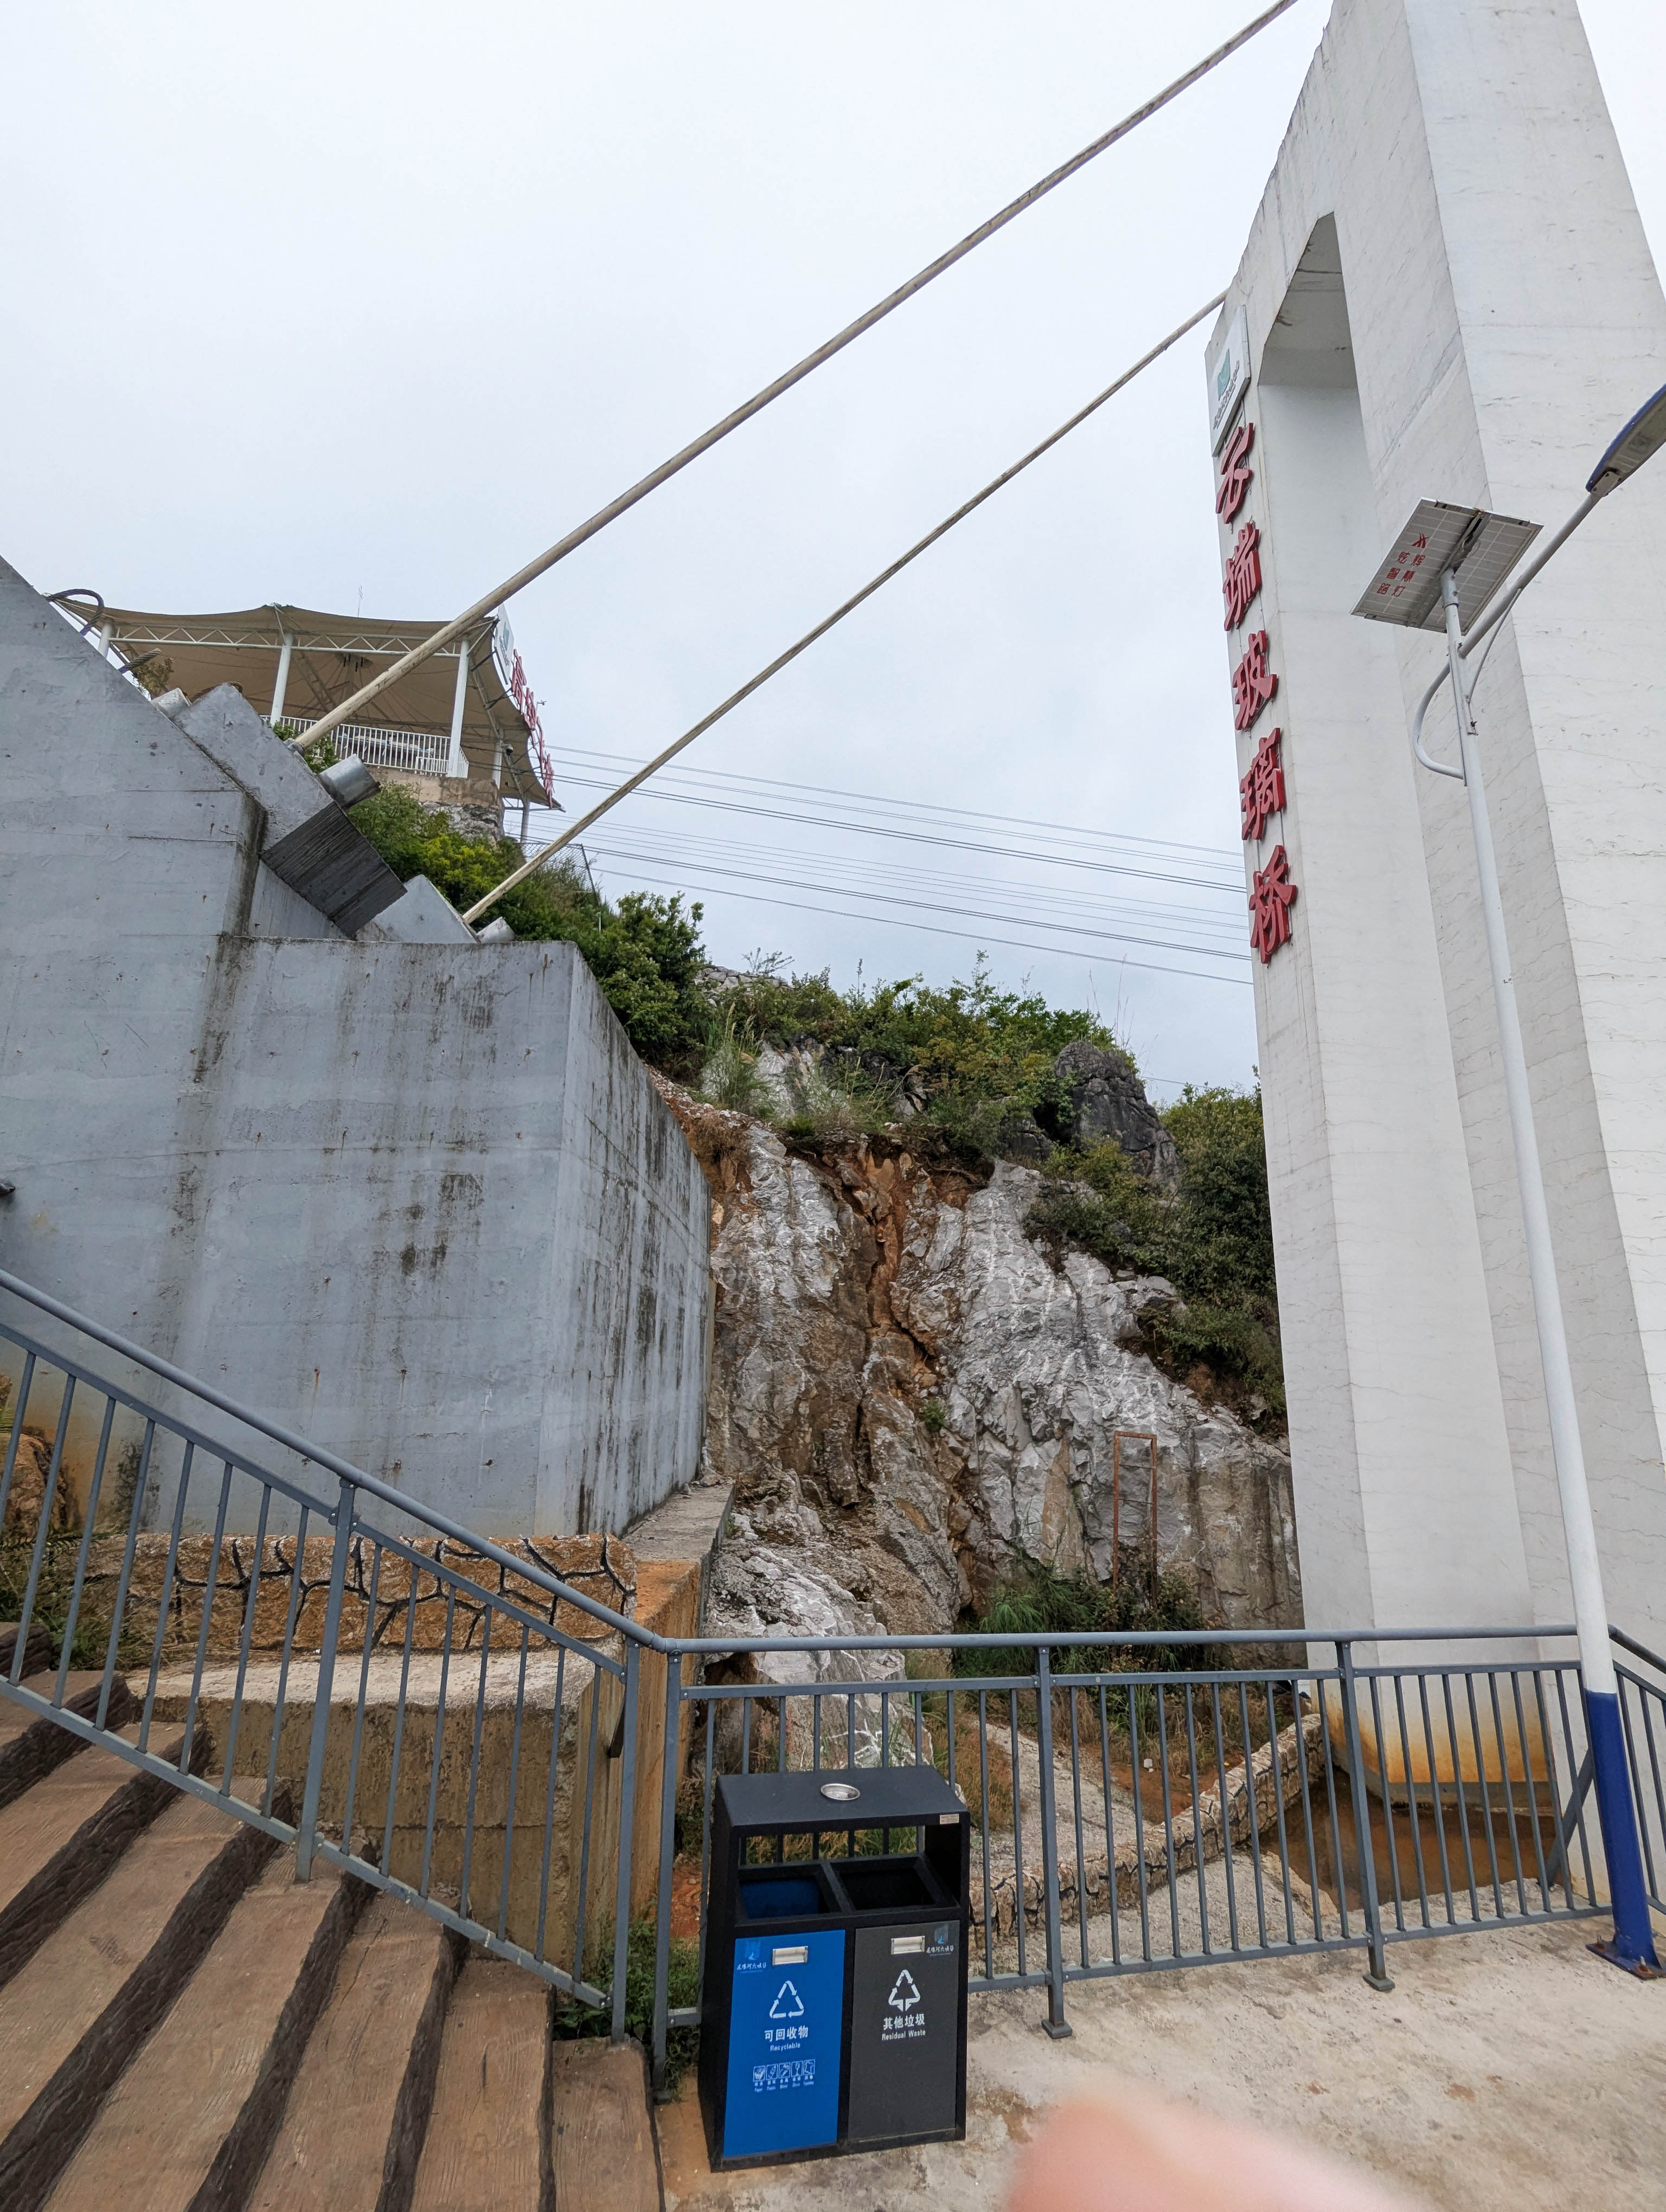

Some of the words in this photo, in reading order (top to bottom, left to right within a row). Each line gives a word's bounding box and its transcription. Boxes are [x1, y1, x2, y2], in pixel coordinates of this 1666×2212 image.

[1386, 567, 1415, 582] 智慧
[1377, 583, 1406, 597] 路灯
[1216, 422, 1296, 964] 云端玻璃桥
[883, 2013, 925, 2030] 其他垃圾
[764, 2025, 809, 2042] 可回收物
[882, 2031, 906, 2041] Residual
[908, 2029, 926, 2037] Waste
[770, 2042, 800, 2052] Recyclable
